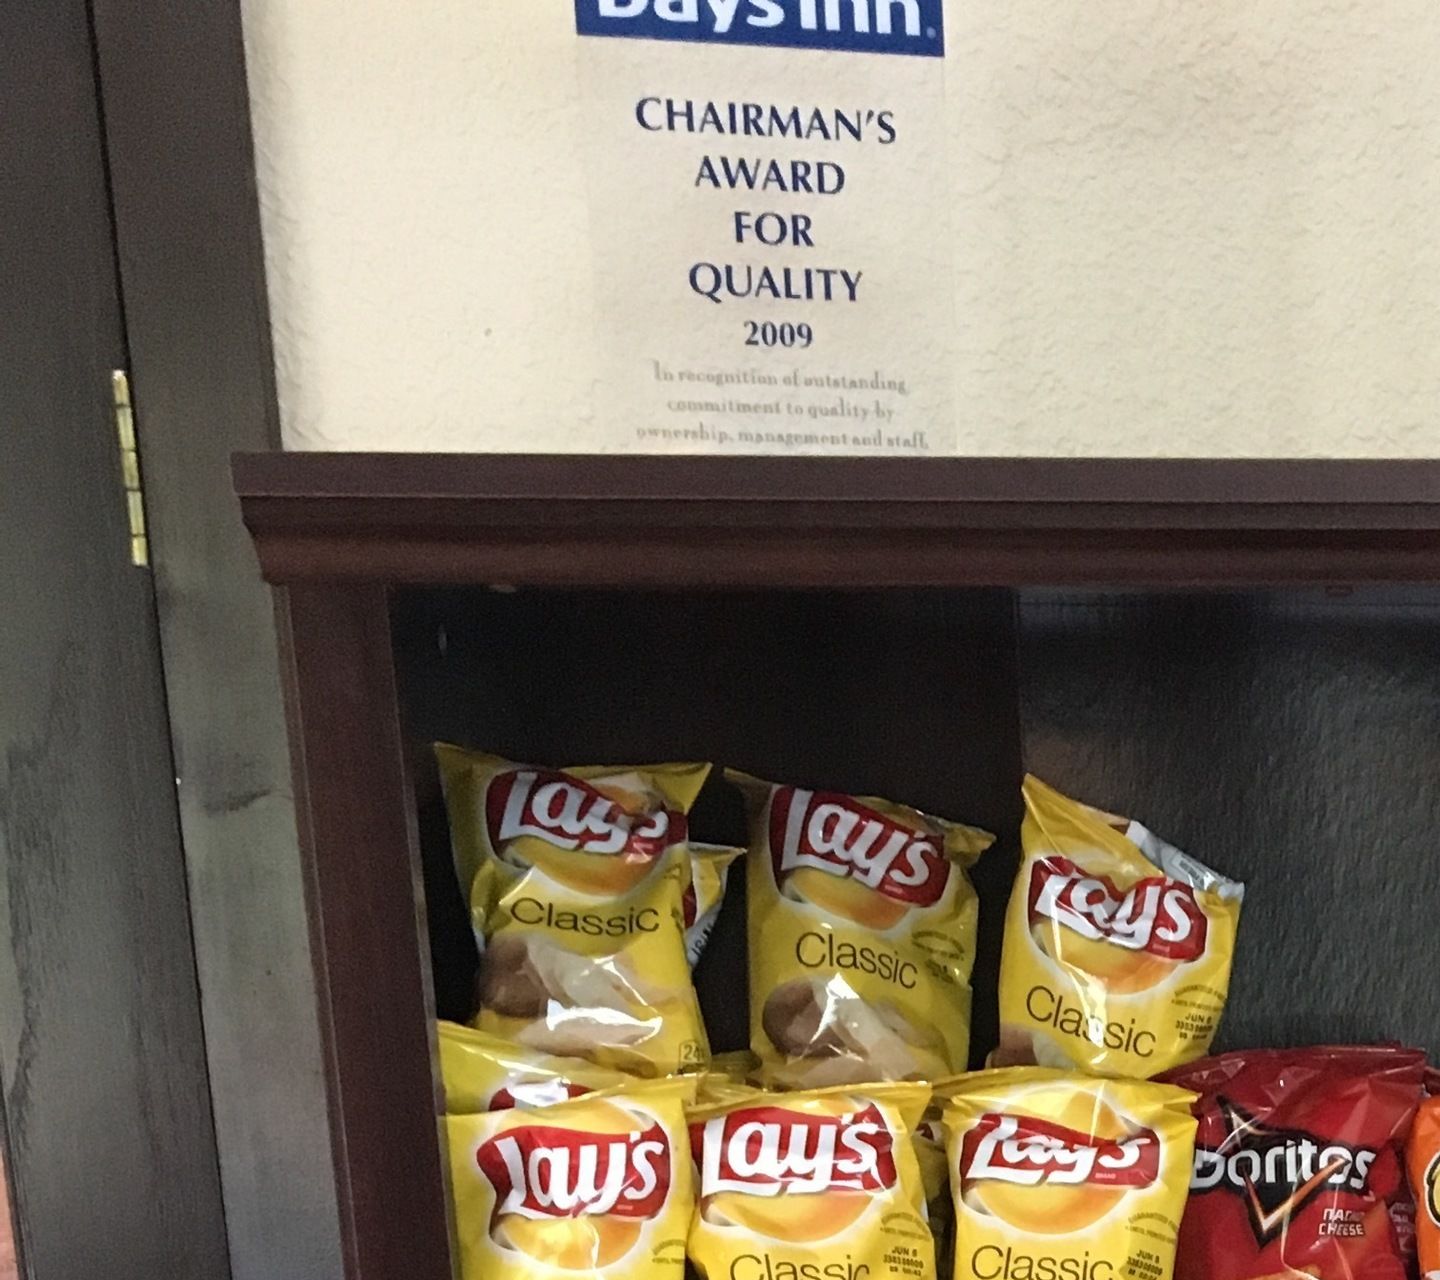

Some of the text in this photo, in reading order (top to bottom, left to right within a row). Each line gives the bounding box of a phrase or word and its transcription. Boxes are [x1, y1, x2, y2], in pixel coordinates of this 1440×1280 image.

[635, 96, 896, 144] CHAIRMAN'S
[694, 155, 846, 195] AWARD
[734, 211, 814, 247] FOR
[689, 262, 862, 303] QUALITY
[743, 321, 813, 348] 2009
[679, 366, 777, 390] recognition
[783, 368, 800, 386] of
[804, 371, 906, 395] outstanding
[668, 400, 895, 421] commitment to quality by
[738, 430, 848, 450] management
[851, 430, 882, 447] and
[781, 786, 938, 889] Lay's
[511, 897, 660, 938] Classic
[1034, 872, 1192, 950] Lay's
[795, 932, 919, 990] Classic
[1026, 985, 1156, 1059] Classic
[495, 1131, 665, 1218] Lay's
[701, 1113, 879, 1199] Lay's
[1191, 1139, 1376, 1191] Doritos
[1319, 1221, 1365, 1237] CHEESE
